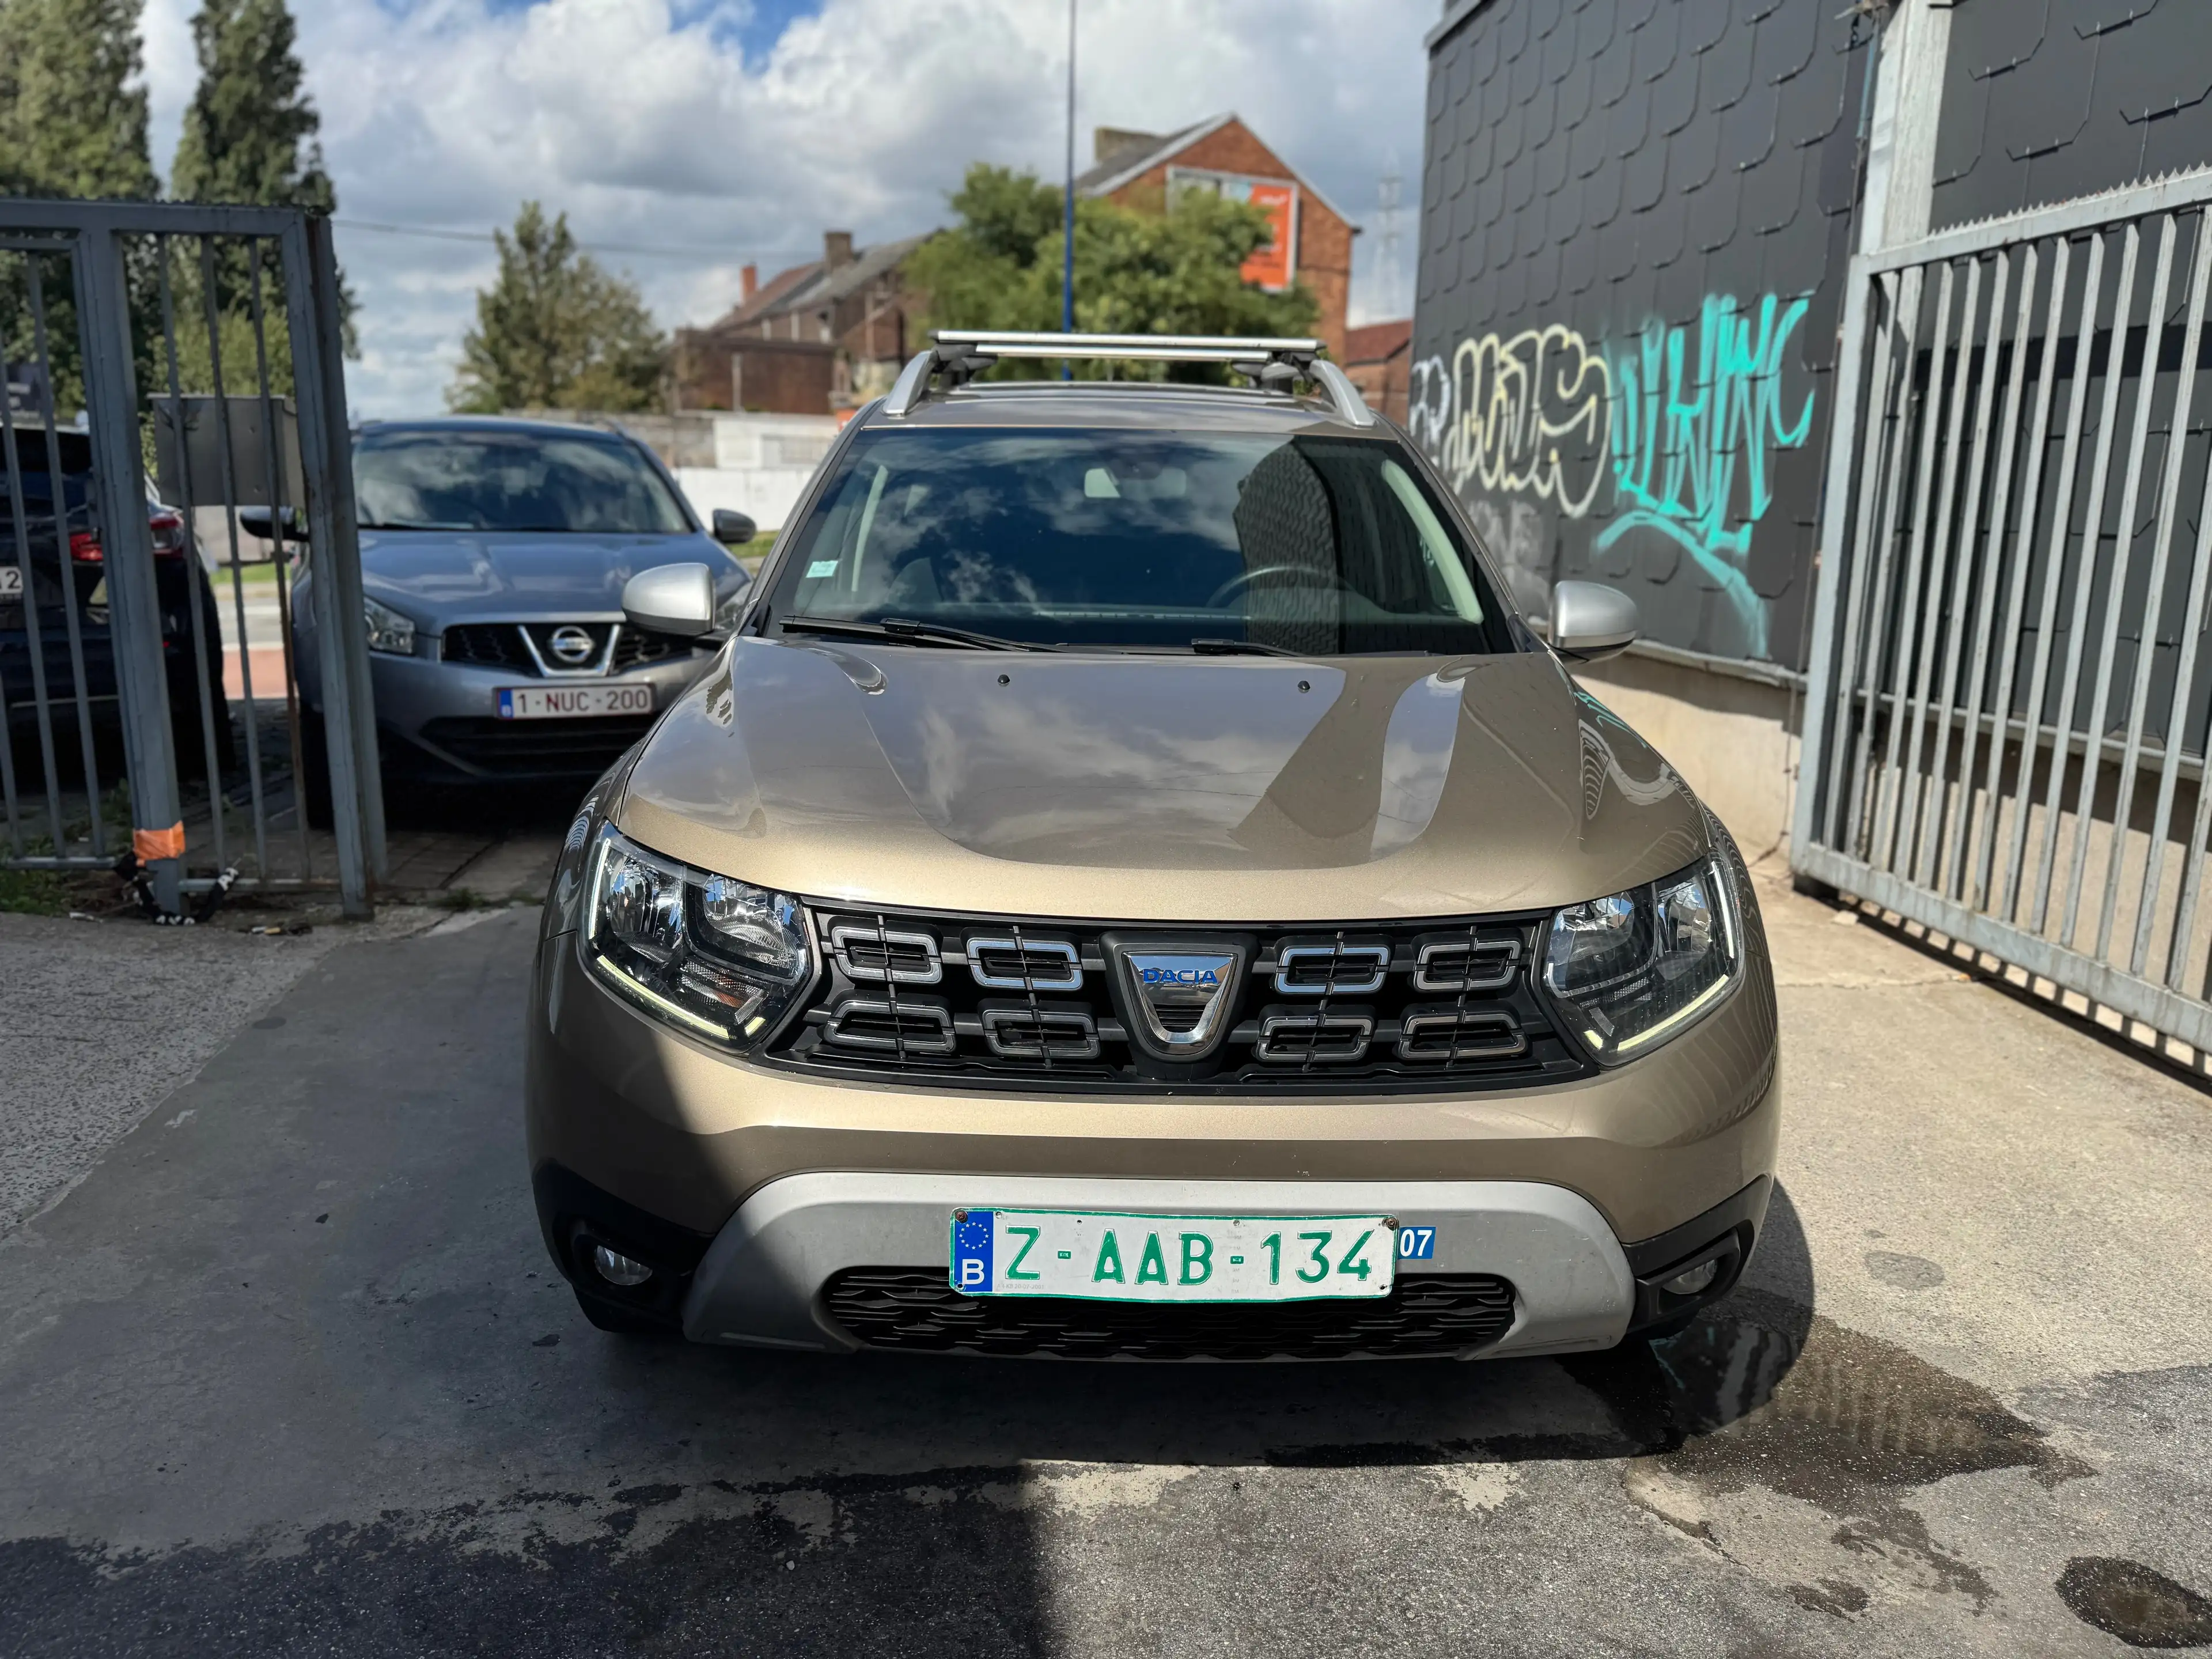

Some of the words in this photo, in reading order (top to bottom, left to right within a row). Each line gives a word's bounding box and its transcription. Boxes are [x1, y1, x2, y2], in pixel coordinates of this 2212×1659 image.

[1142, 968, 1219, 984] DACIA
[1005, 1225, 1375, 1286] Z-AAB-134
[1399, 1229, 1433, 1257] 07
[962, 1259, 984, 1285] B
